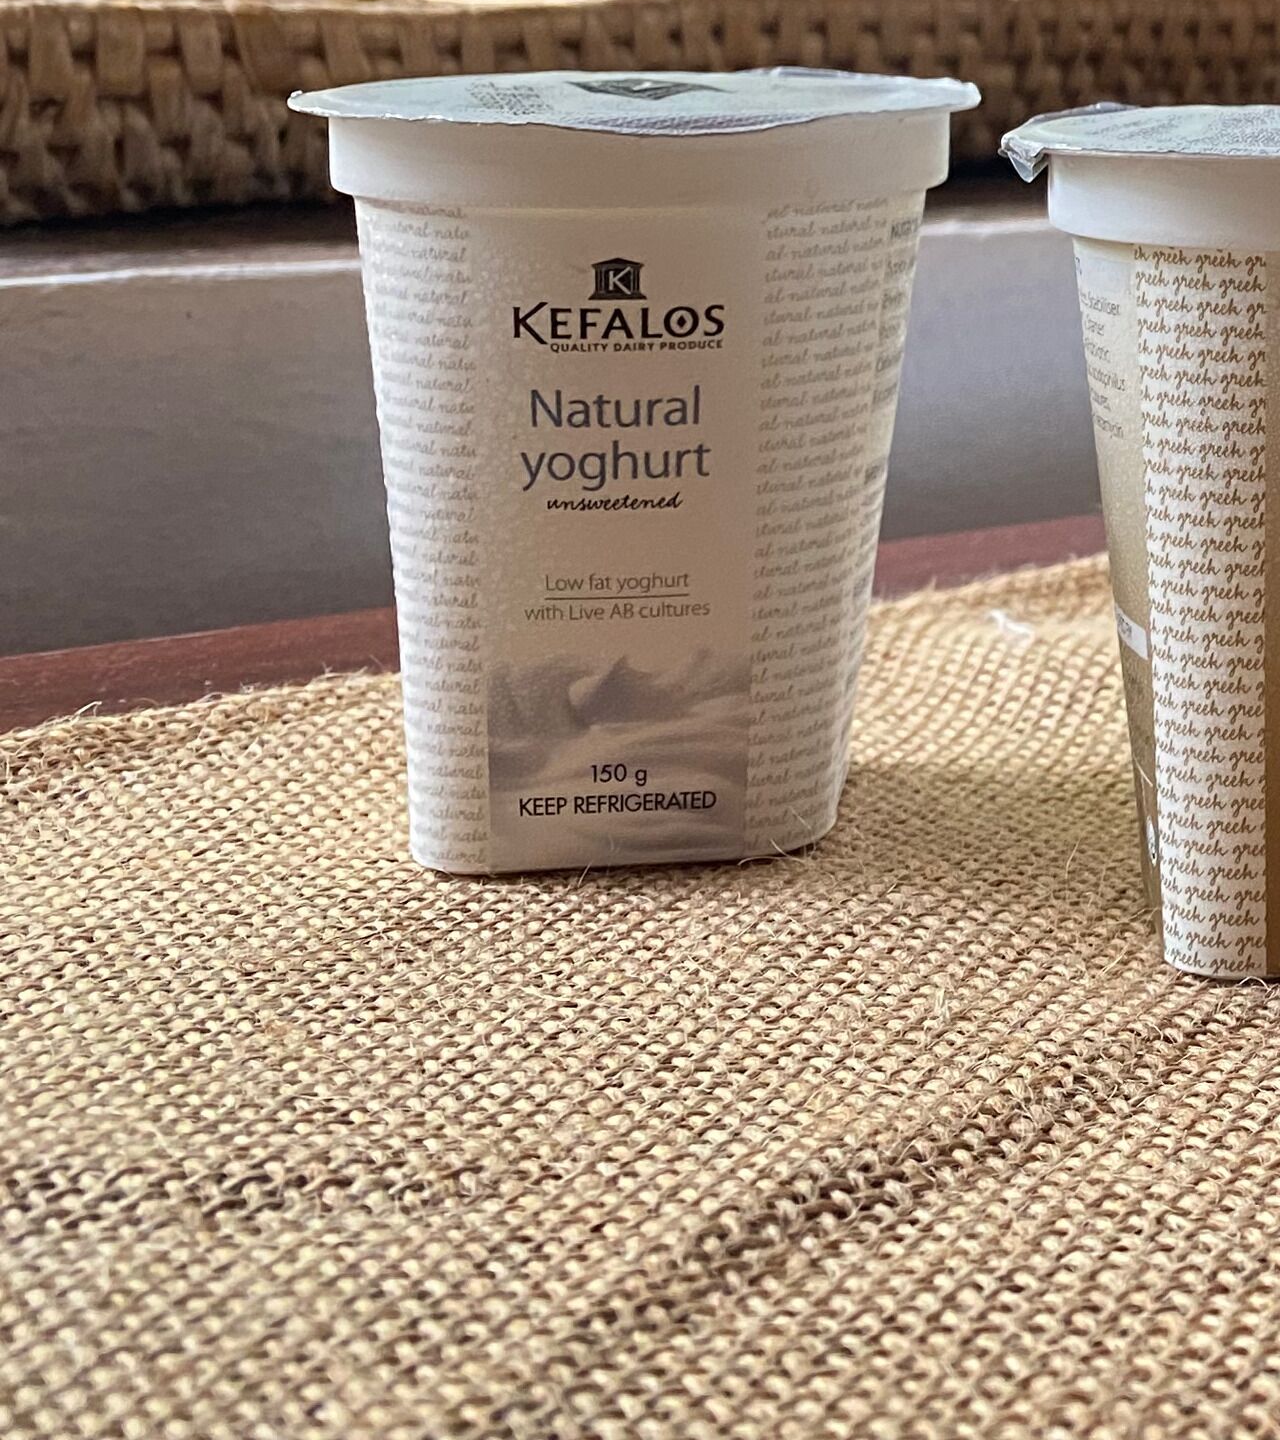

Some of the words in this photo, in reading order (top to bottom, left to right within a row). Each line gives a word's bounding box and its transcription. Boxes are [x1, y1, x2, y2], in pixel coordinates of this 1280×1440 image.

[608, 266, 632, 295] K
[513, 301, 725, 345] KEFALOS
[550, 342, 608, 353] QUALITY
[613, 342, 654, 352] DAIRY
[659, 339, 723, 351] PRODUCE
[531, 384, 700, 428] Natural
[520, 439, 711, 491] yoghurt
[546, 491, 683, 510] unsweetened
[545, 574, 584, 591] Low
[588, 573, 610, 591] fat
[615, 572, 689, 593] yoghurt
[524, 605, 564, 621] with
[569, 605, 604, 621] Live
[610, 603, 634, 619] AB
[638, 601, 711, 618] cultures
[590, 763, 627, 783] 150
[634, 768, 647, 787] g
[519, 797, 567, 817] KEEP
[573, 791, 717, 814] REFRIGERATED
